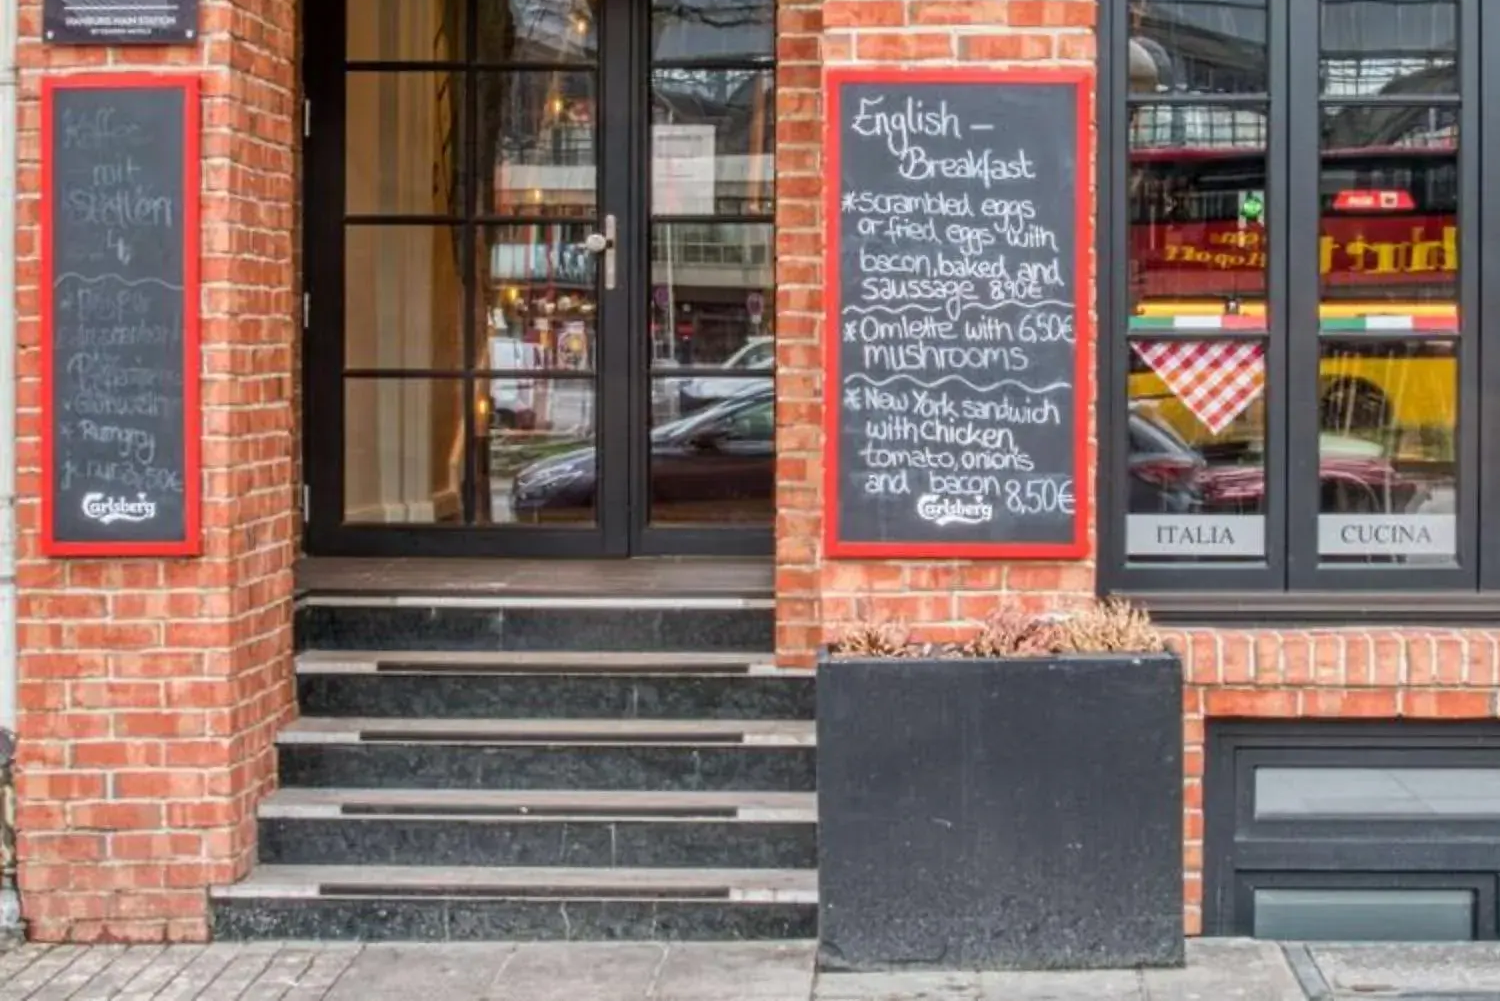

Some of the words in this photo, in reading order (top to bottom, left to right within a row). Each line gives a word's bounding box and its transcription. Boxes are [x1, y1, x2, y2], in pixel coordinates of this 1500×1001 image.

[851, 96, 962, 157] English
[898, 145, 1036, 189] Breakfast
[981, 198, 1036, 233] eggs
[857, 216, 883, 236] or
[884, 215, 942, 244] fried
[946, 223, 997, 256] eggs
[1006, 223, 1060, 253] with
[1017, 257, 1064, 286] and
[861, 277, 978, 319] saussage
[860, 316, 958, 341] Omlette
[964, 315, 1014, 341] with
[864, 341, 1029, 370] mushrooms
[864, 389, 909, 412] New
[912, 390, 960, 418] York
[962, 395, 1061, 425] sandwich
[865, 417, 918, 443] with
[82, 492, 156, 525] Carlsberg
[864, 472, 911, 495] and
[929, 471, 1001, 496] bacon
[1003, 478, 1076, 514] 8,50€
[917, 494, 993, 525] Carlsberg
[1156, 525, 1236, 544] ITALIA
[1340, 524, 1432, 544] CUCINA
